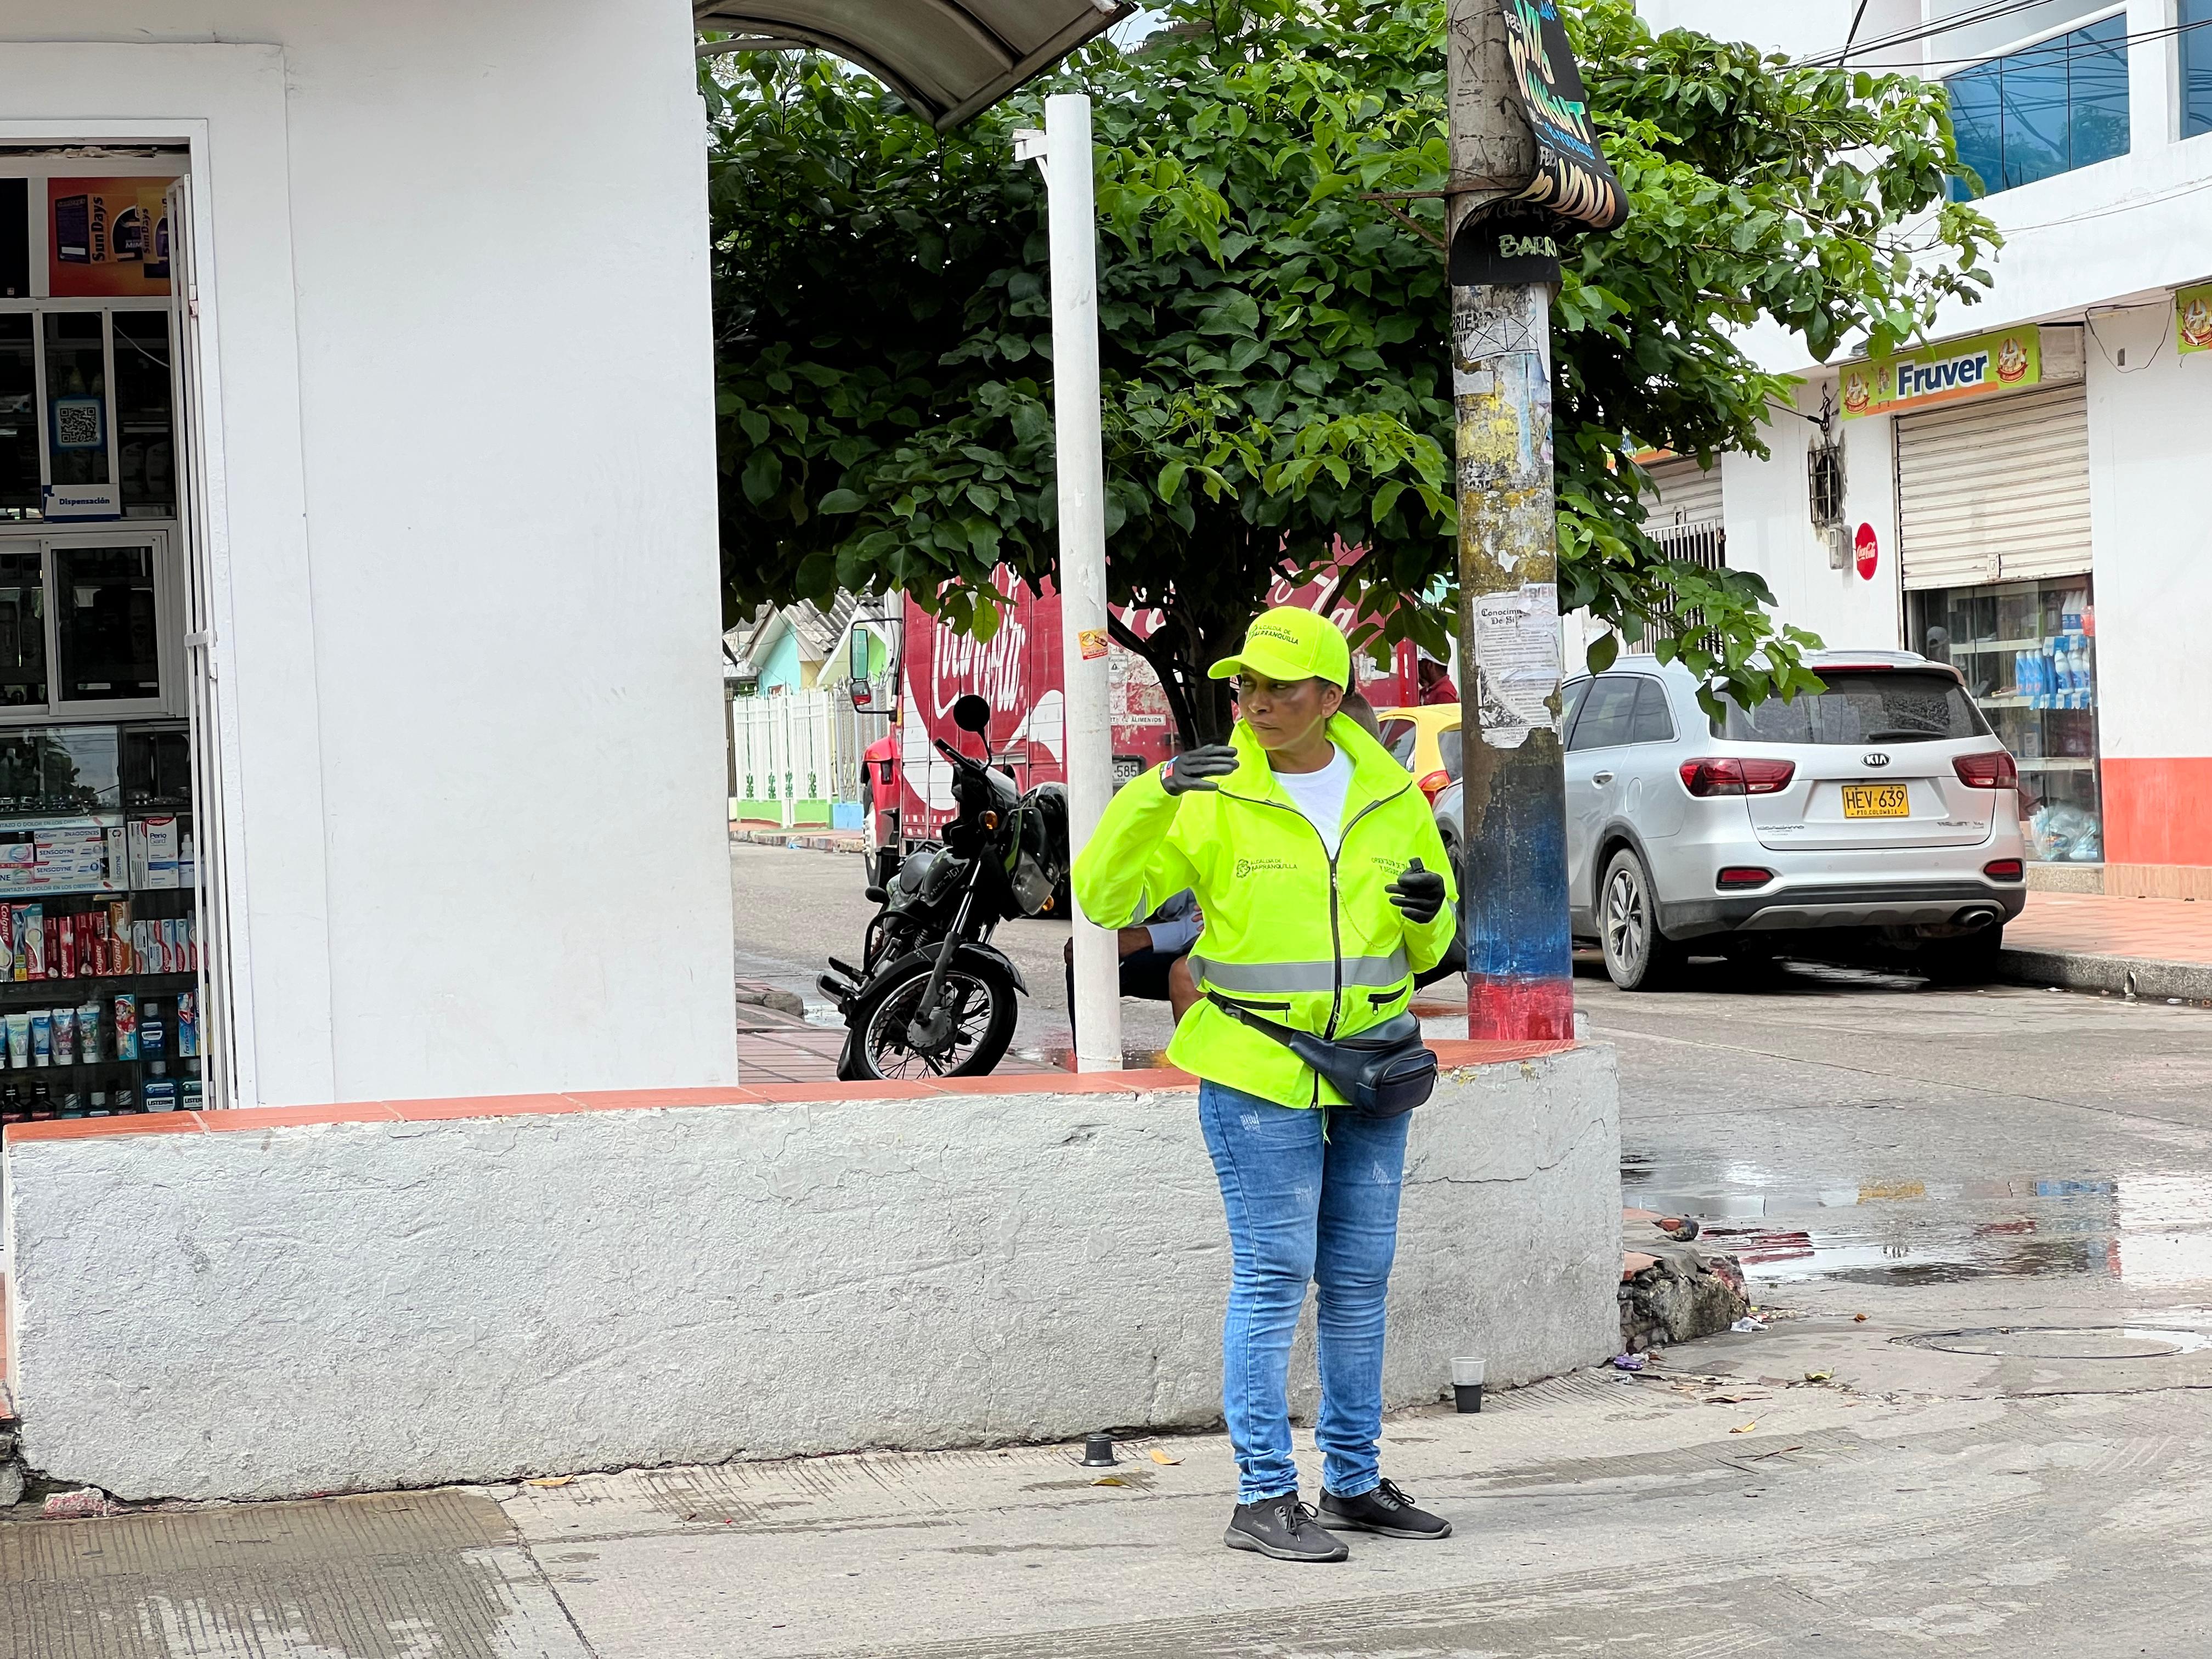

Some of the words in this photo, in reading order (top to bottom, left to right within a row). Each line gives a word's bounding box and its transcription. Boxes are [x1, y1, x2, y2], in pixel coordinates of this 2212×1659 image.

[1898, 355, 1988, 396] Fruver
[59, 497, 110, 506] Dispensación
[1866, 755, 1887, 765] KIA
[1116, 765, 1137, 777] 585
[1845, 790, 1872, 809] HEV
[1878, 790, 1905, 808] 639
[1, 905, 9, 941] Colgate
[113, 939, 122, 974] Colgate
